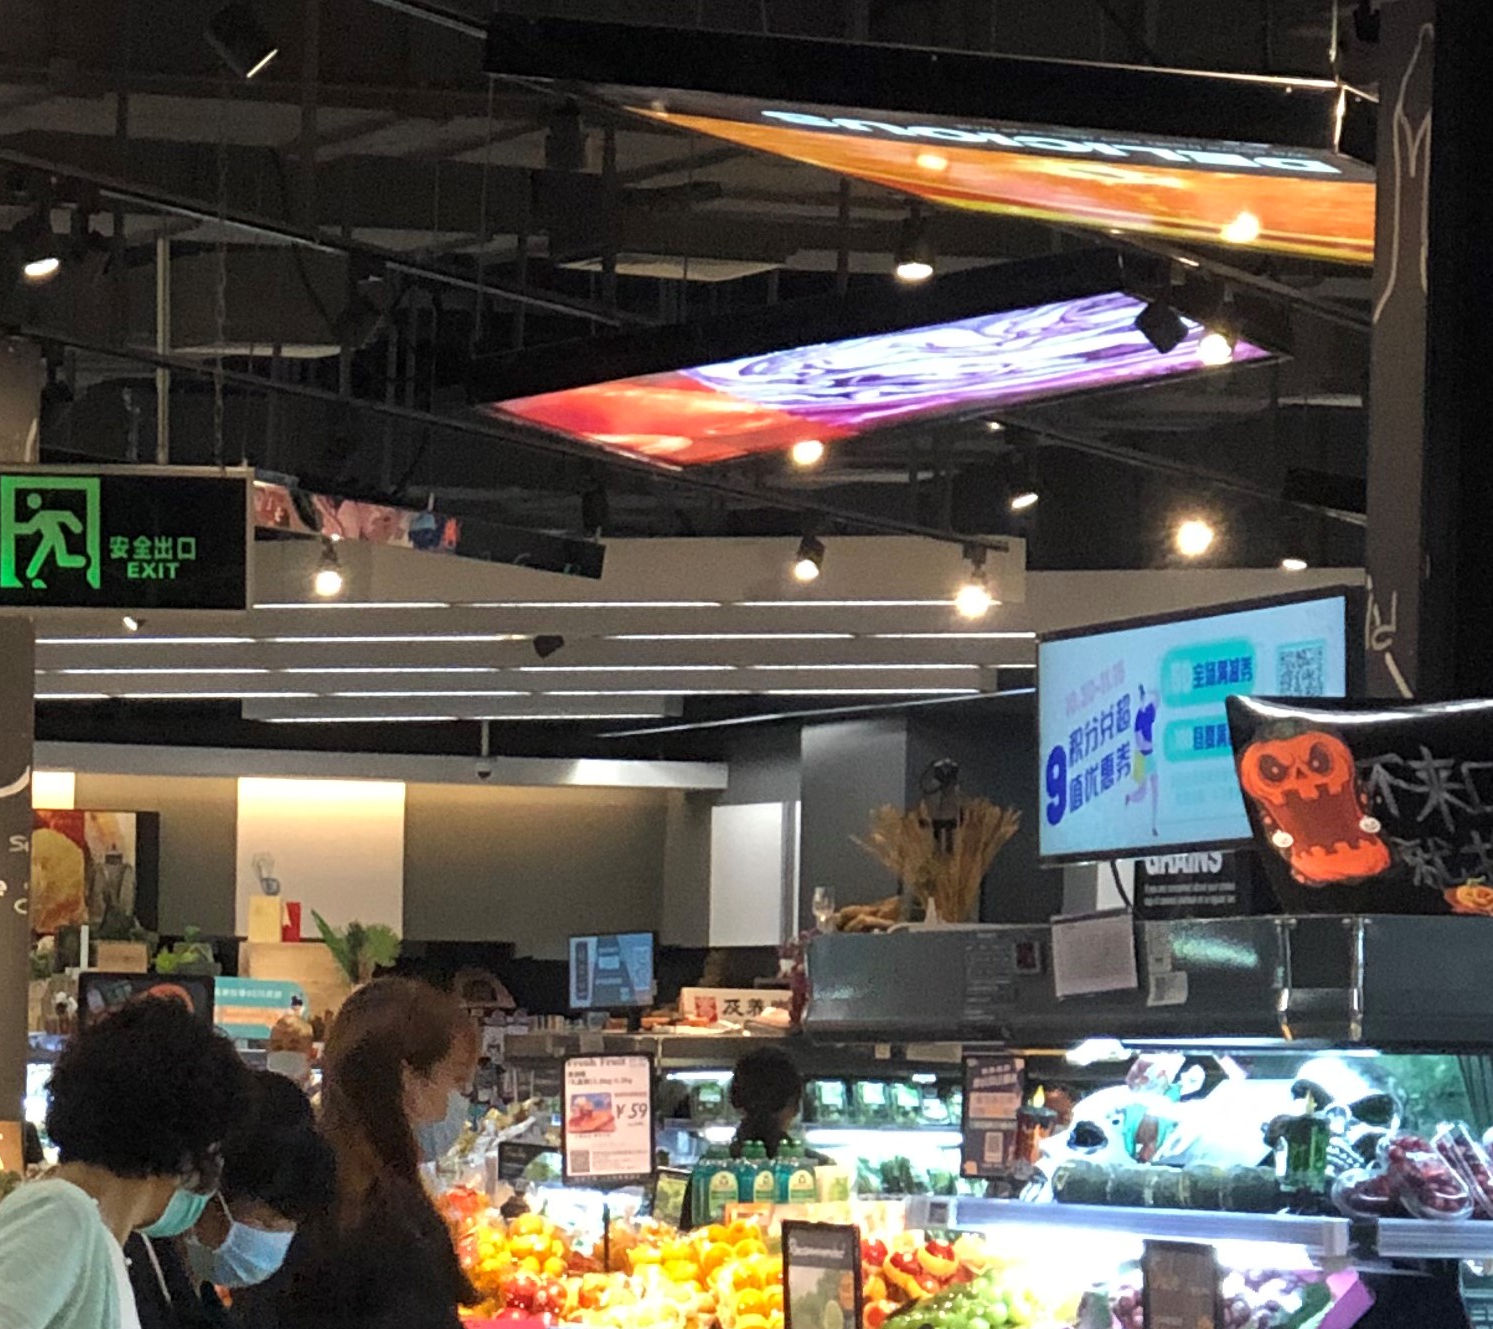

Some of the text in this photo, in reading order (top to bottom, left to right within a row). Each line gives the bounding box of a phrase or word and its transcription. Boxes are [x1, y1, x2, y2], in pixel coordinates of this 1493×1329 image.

[761, 109, 1342, 174] DELICIOUS
[109, 535, 196, 560] 安全出口
[127, 562, 180, 579] EXIT
[1046, 745, 1067, 826] 9
[627, 1103, 648, 1119] 59
